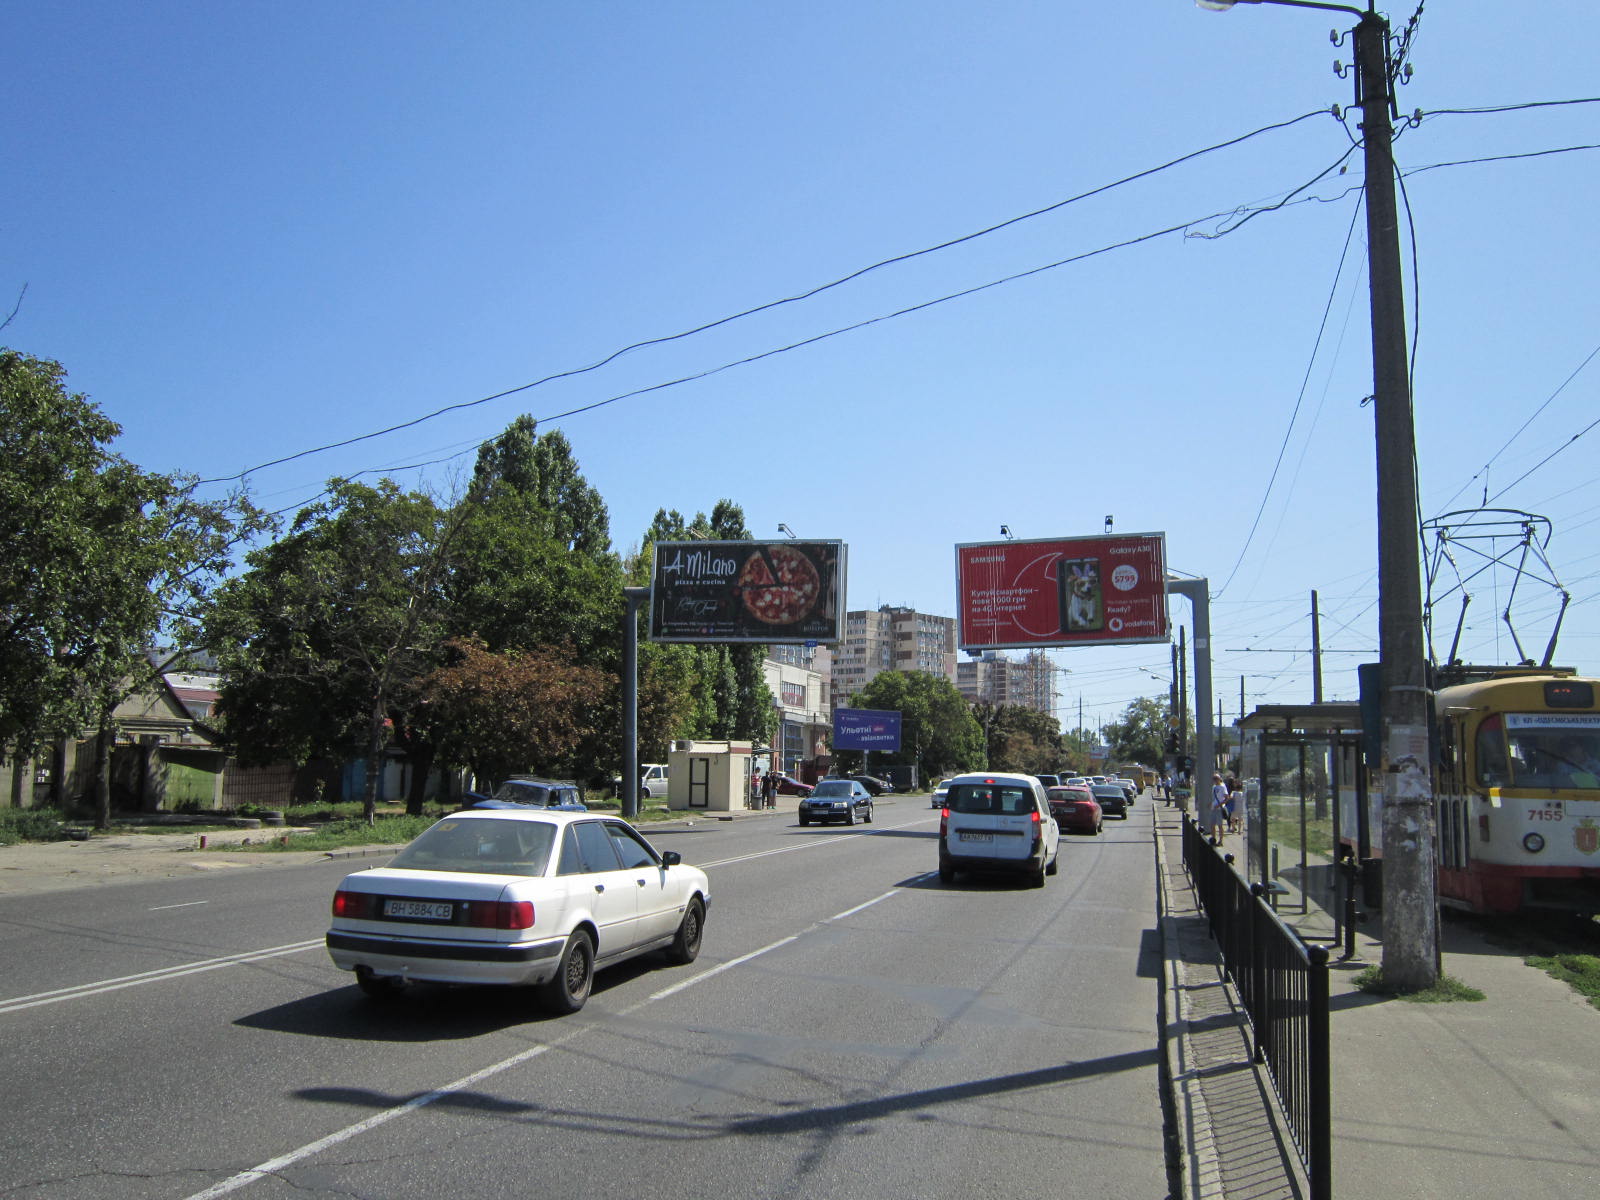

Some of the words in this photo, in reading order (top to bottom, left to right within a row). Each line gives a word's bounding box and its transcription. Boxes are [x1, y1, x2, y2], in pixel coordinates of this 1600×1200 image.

[1109, 547, 1136, 555] Galaxy
[970, 555, 1006, 564] SAMSUNG
[996, 587, 1033, 597] смартфон
[1013, 596, 1026, 604] грн
[1107, 605, 1131, 614] Ready?
[1124, 620, 1155, 629] vodafone
[1528, 809, 1563, 822] 7155
[391, 902, 405, 914] BH
[408, 903, 433, 917] 5884
[436, 904, 450, 918] CB
